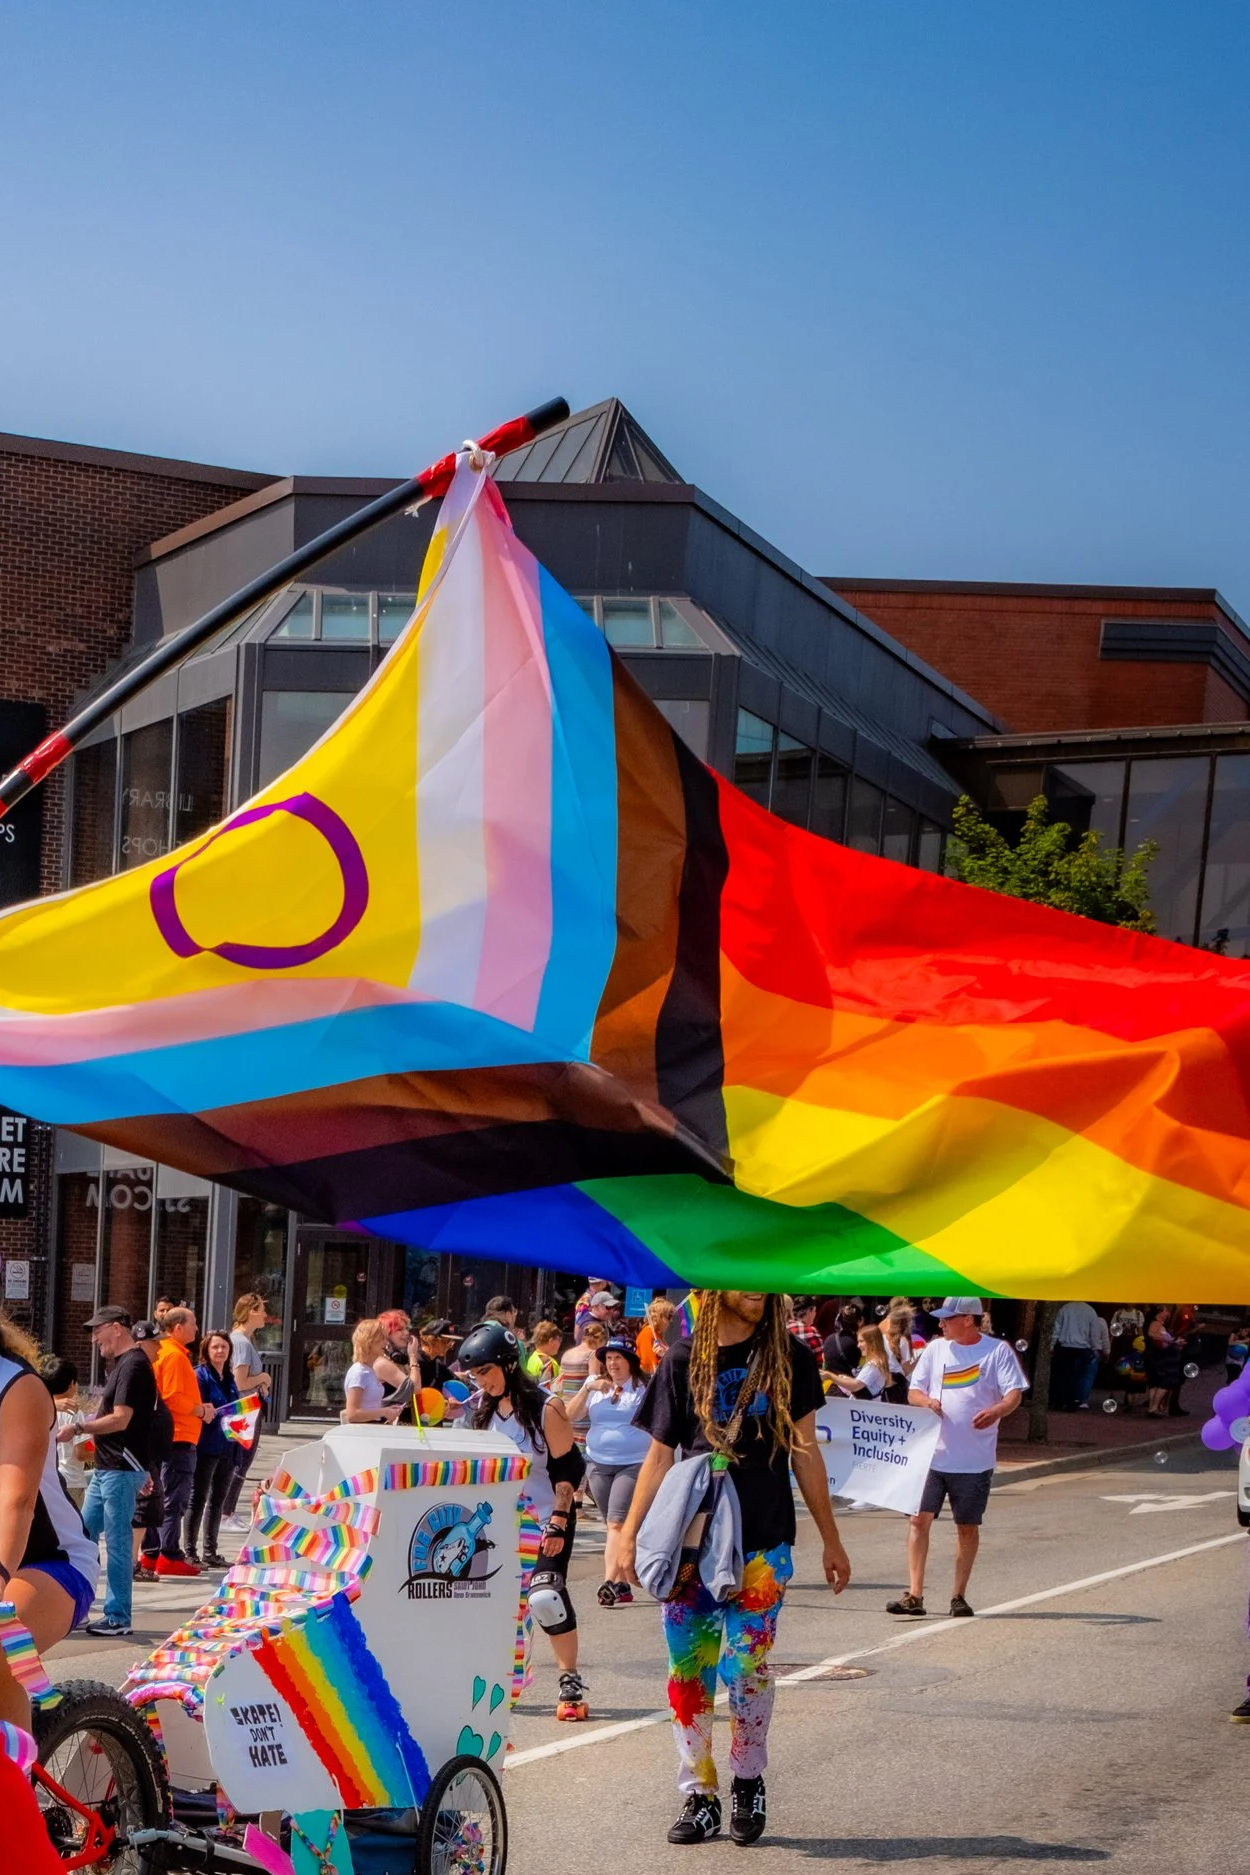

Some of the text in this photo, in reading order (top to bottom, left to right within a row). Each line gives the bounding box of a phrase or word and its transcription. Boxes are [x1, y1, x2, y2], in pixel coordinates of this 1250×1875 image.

[850, 1409, 916, 1433] Diversity,
[852, 1426, 907, 1446] Equity +
[853, 1443, 909, 1467] Inclusion
[412, 1504, 462, 1572] FOG CITY
[408, 1581, 453, 1600] ROLLERS
[230, 1703, 283, 1727] SKATE!
[249, 1725, 276, 1743] DON'T
[249, 1743, 288, 1768] HATE
